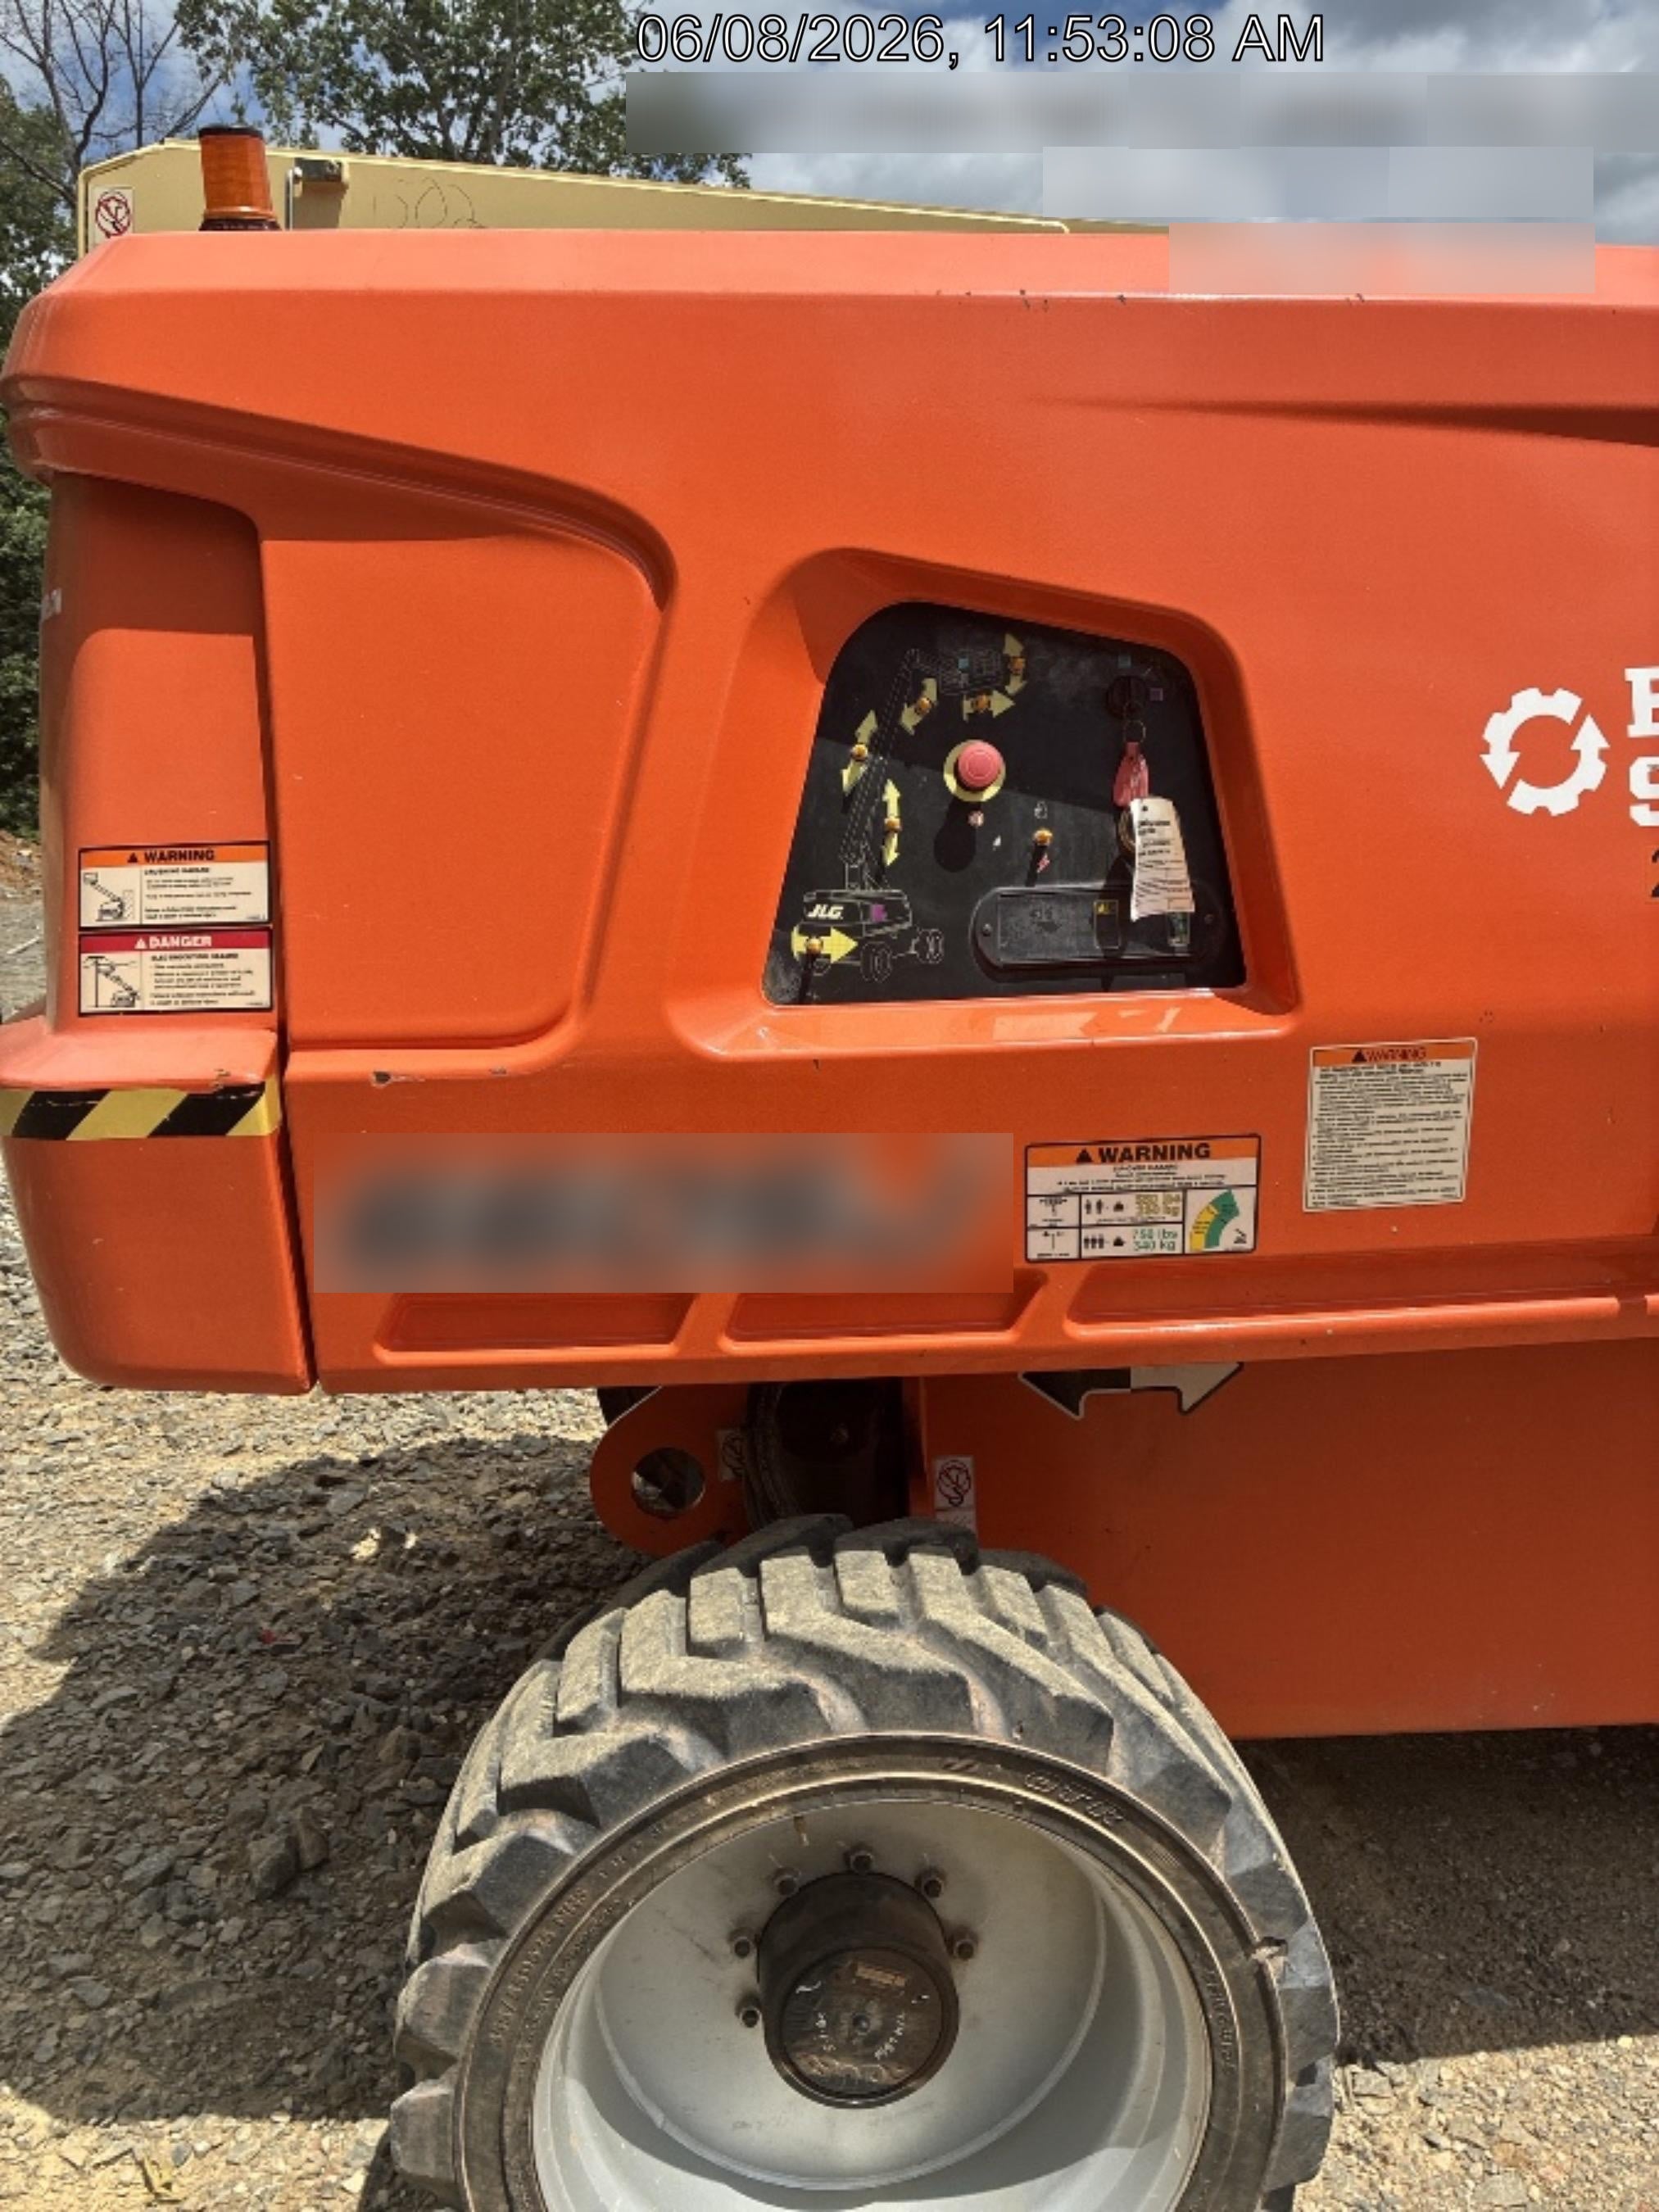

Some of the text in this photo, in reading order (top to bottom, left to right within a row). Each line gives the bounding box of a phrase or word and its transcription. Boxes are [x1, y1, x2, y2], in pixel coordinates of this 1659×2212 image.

[144, 850, 215, 863] WARNING
[808, 904, 844, 920] JLG
[149, 936, 212, 950] DANGER
[1367, 1047, 1426, 1063] WARNING
[1098, 1143, 1210, 1163] WARNING
